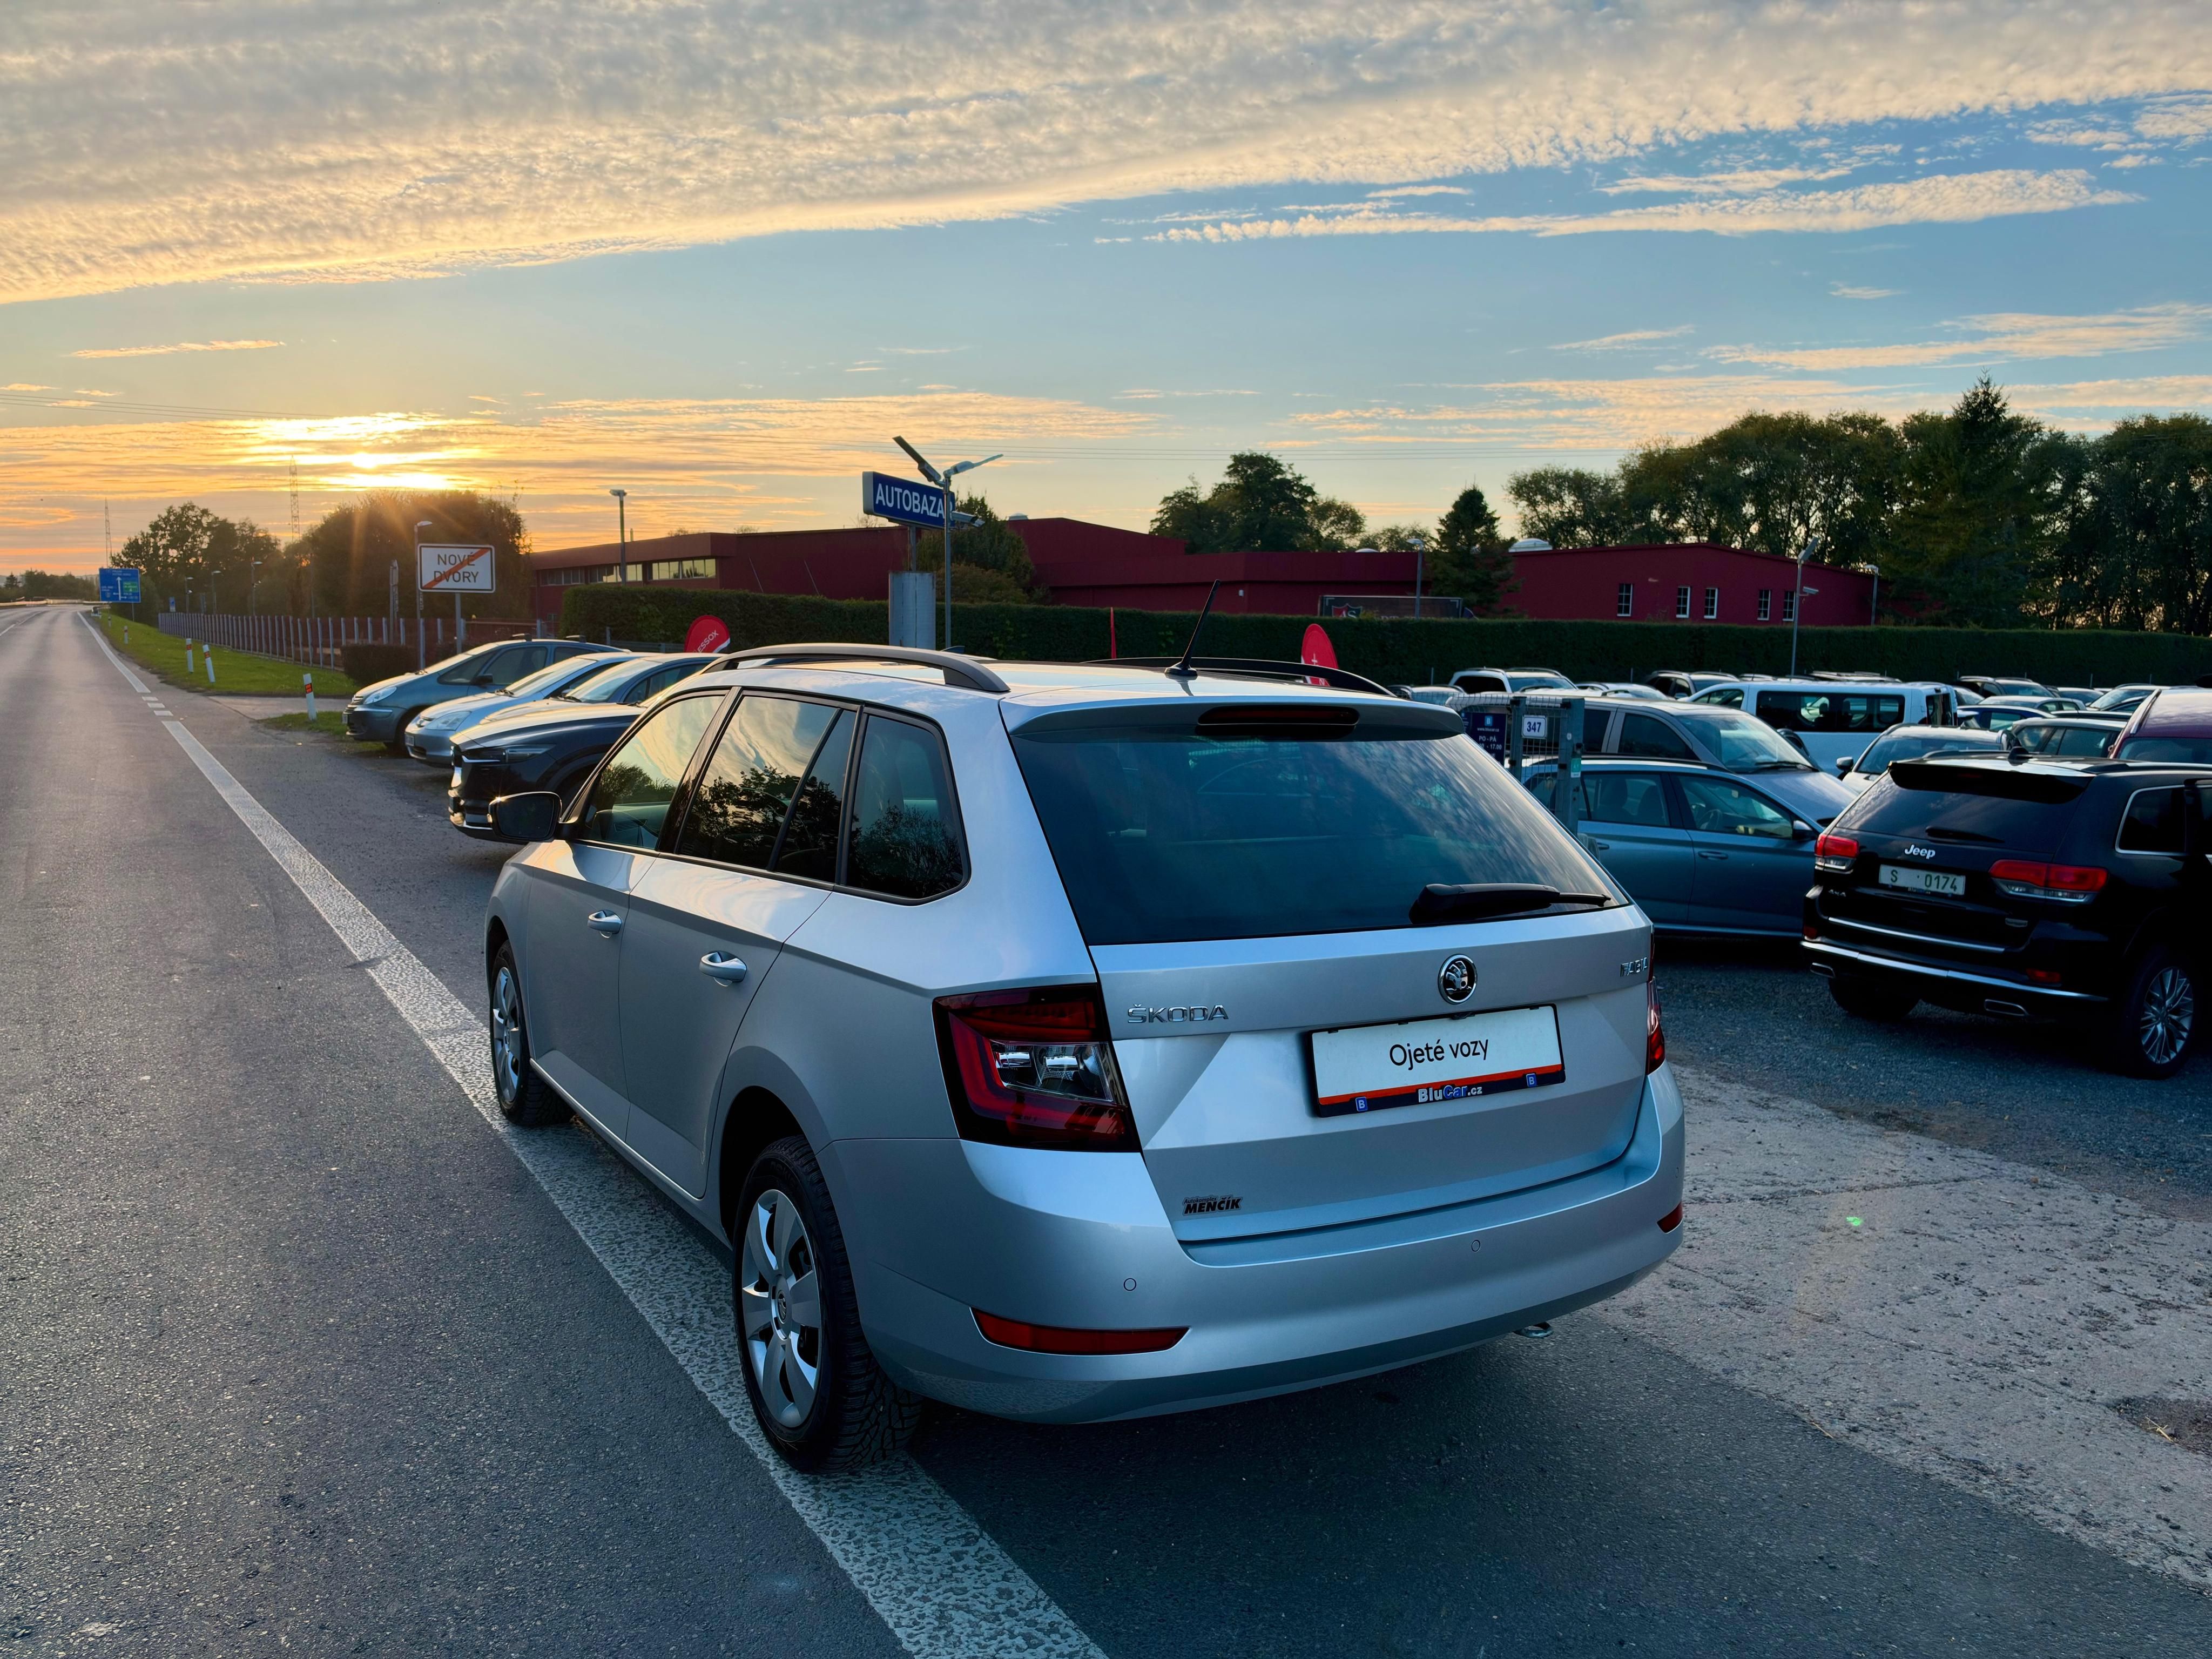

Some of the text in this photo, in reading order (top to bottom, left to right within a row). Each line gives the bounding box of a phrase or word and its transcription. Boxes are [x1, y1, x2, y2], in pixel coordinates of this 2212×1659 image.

[437, 552, 475, 566] NOVÉ
[434, 571, 479, 583] DVORY
[697, 630, 719, 652] ESSOX
[1527, 721, 1541, 733] 347
[1905, 844, 1936, 859] Jeep
[1891, 869, 1898, 883] S
[1924, 873, 1958, 892] 0174
[1128, 1003, 1229, 1023] ŠKODA
[1390, 1038, 1489, 1070] Ojeté vozy
[1528, 1076, 1535, 1085] B
[1418, 1084, 1482, 1103] BluCar.cz
[1359, 1100, 1365, 1109] B
[1184, 1196, 1217, 1204] Autokomplex
[1184, 1197, 1242, 1214] MENČÍK
